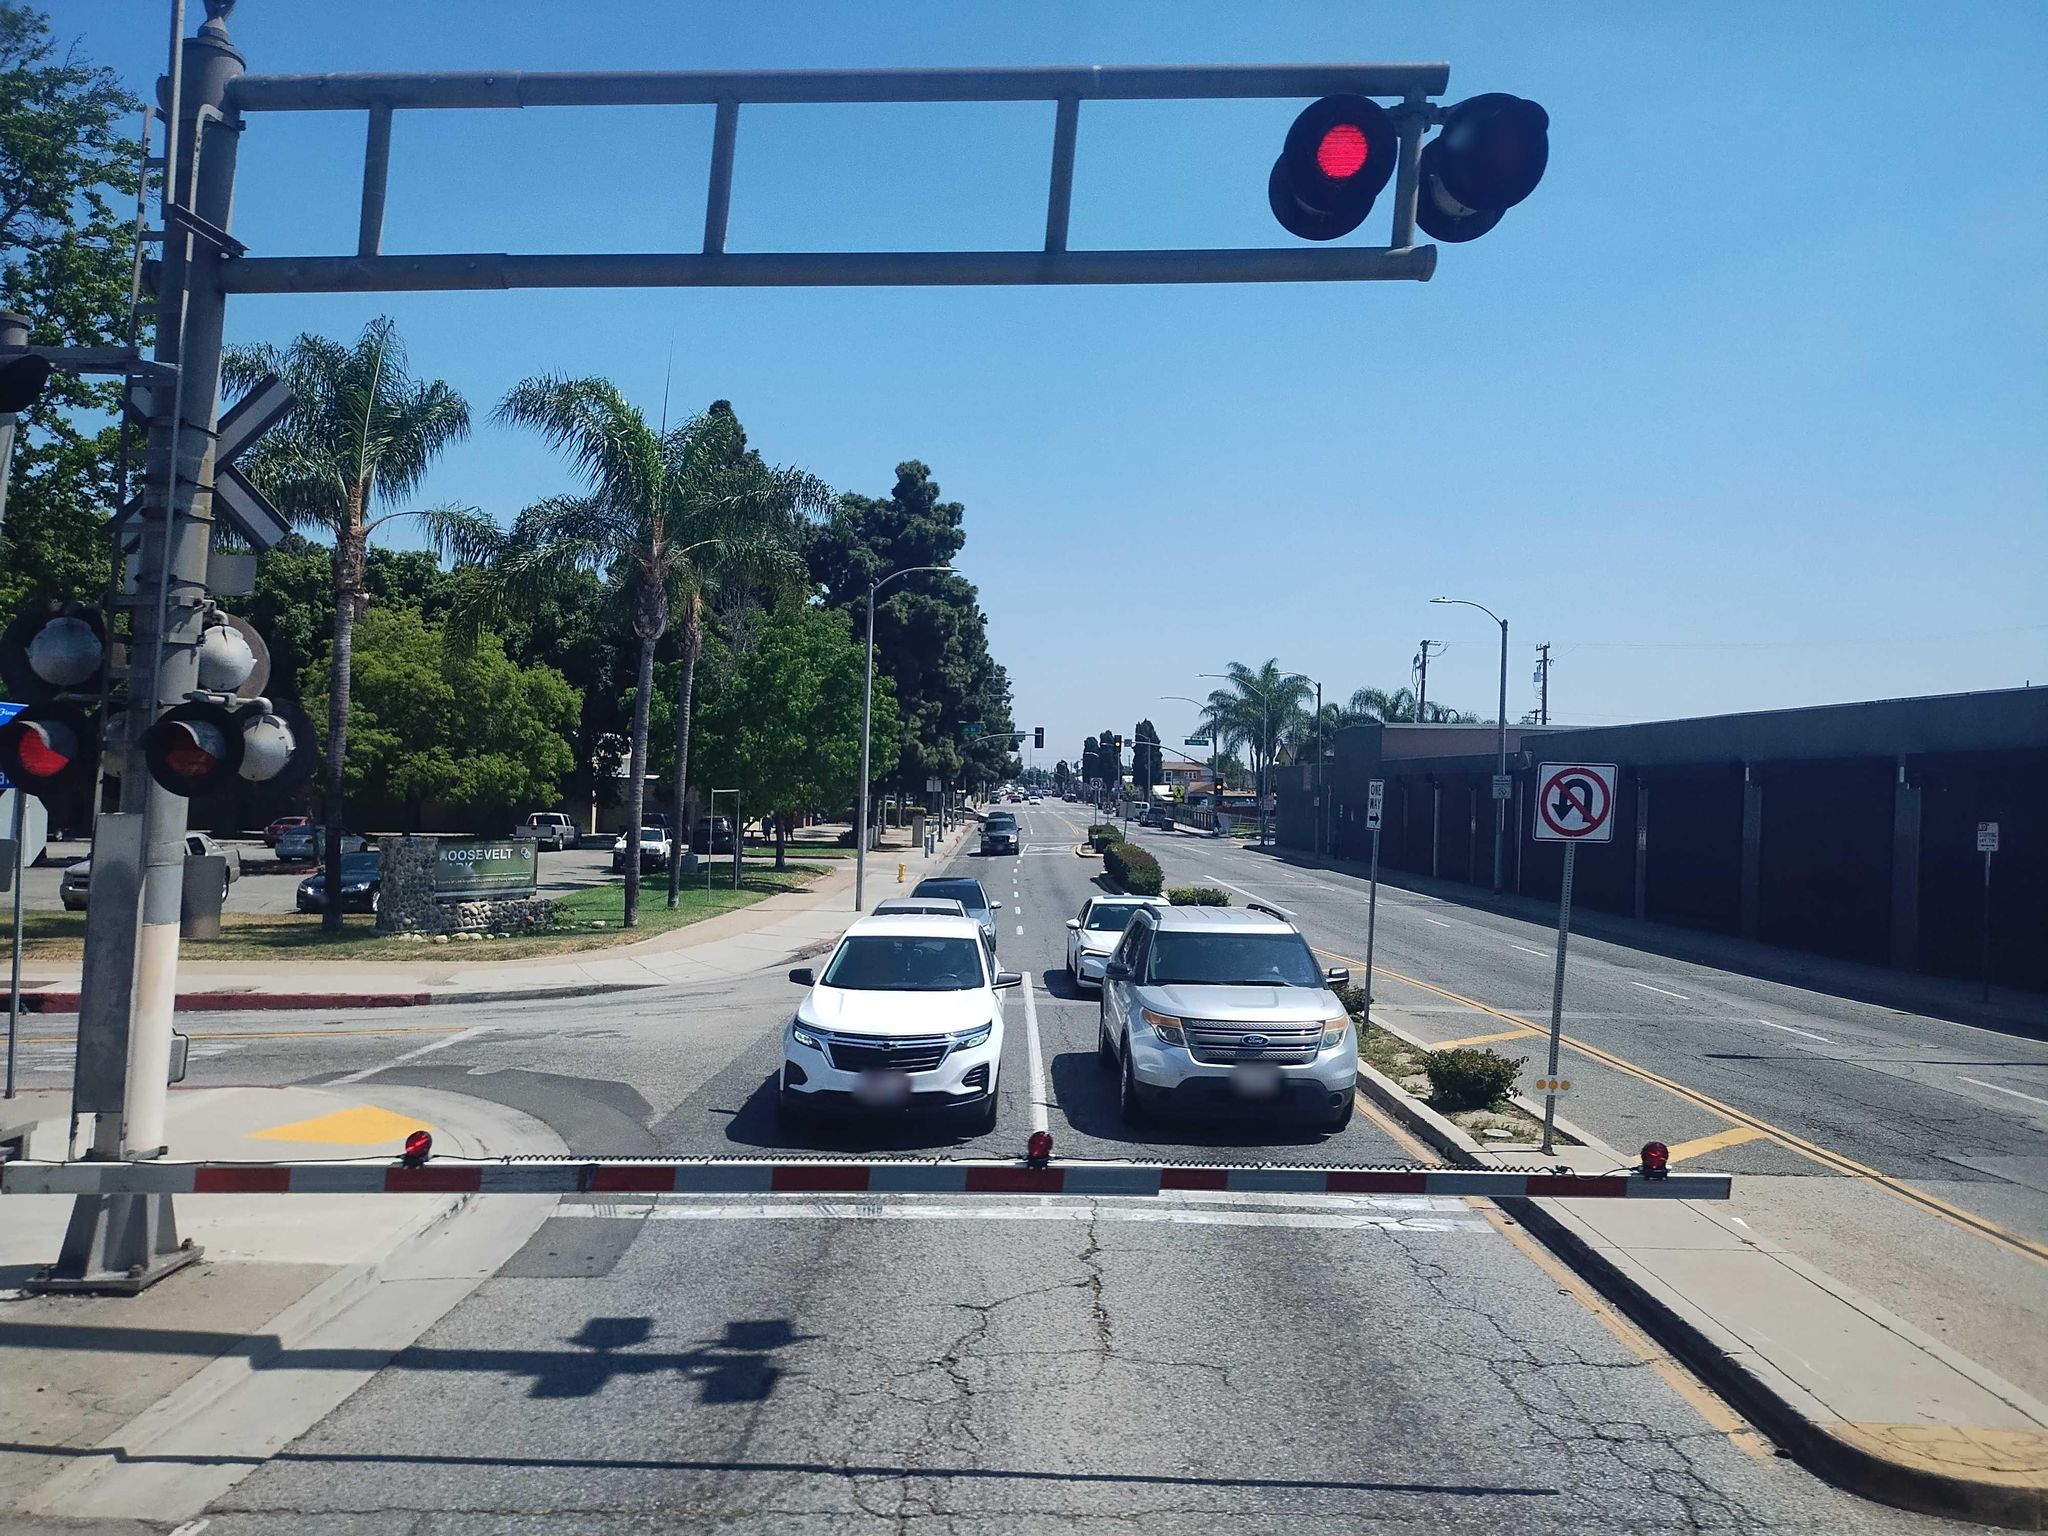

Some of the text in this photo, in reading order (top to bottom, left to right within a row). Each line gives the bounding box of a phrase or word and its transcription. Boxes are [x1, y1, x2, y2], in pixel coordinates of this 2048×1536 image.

[1370, 783, 1382, 796] ONE
[1369, 798, 1382, 810] WAY
[440, 848, 513, 861] OOSEVELT
